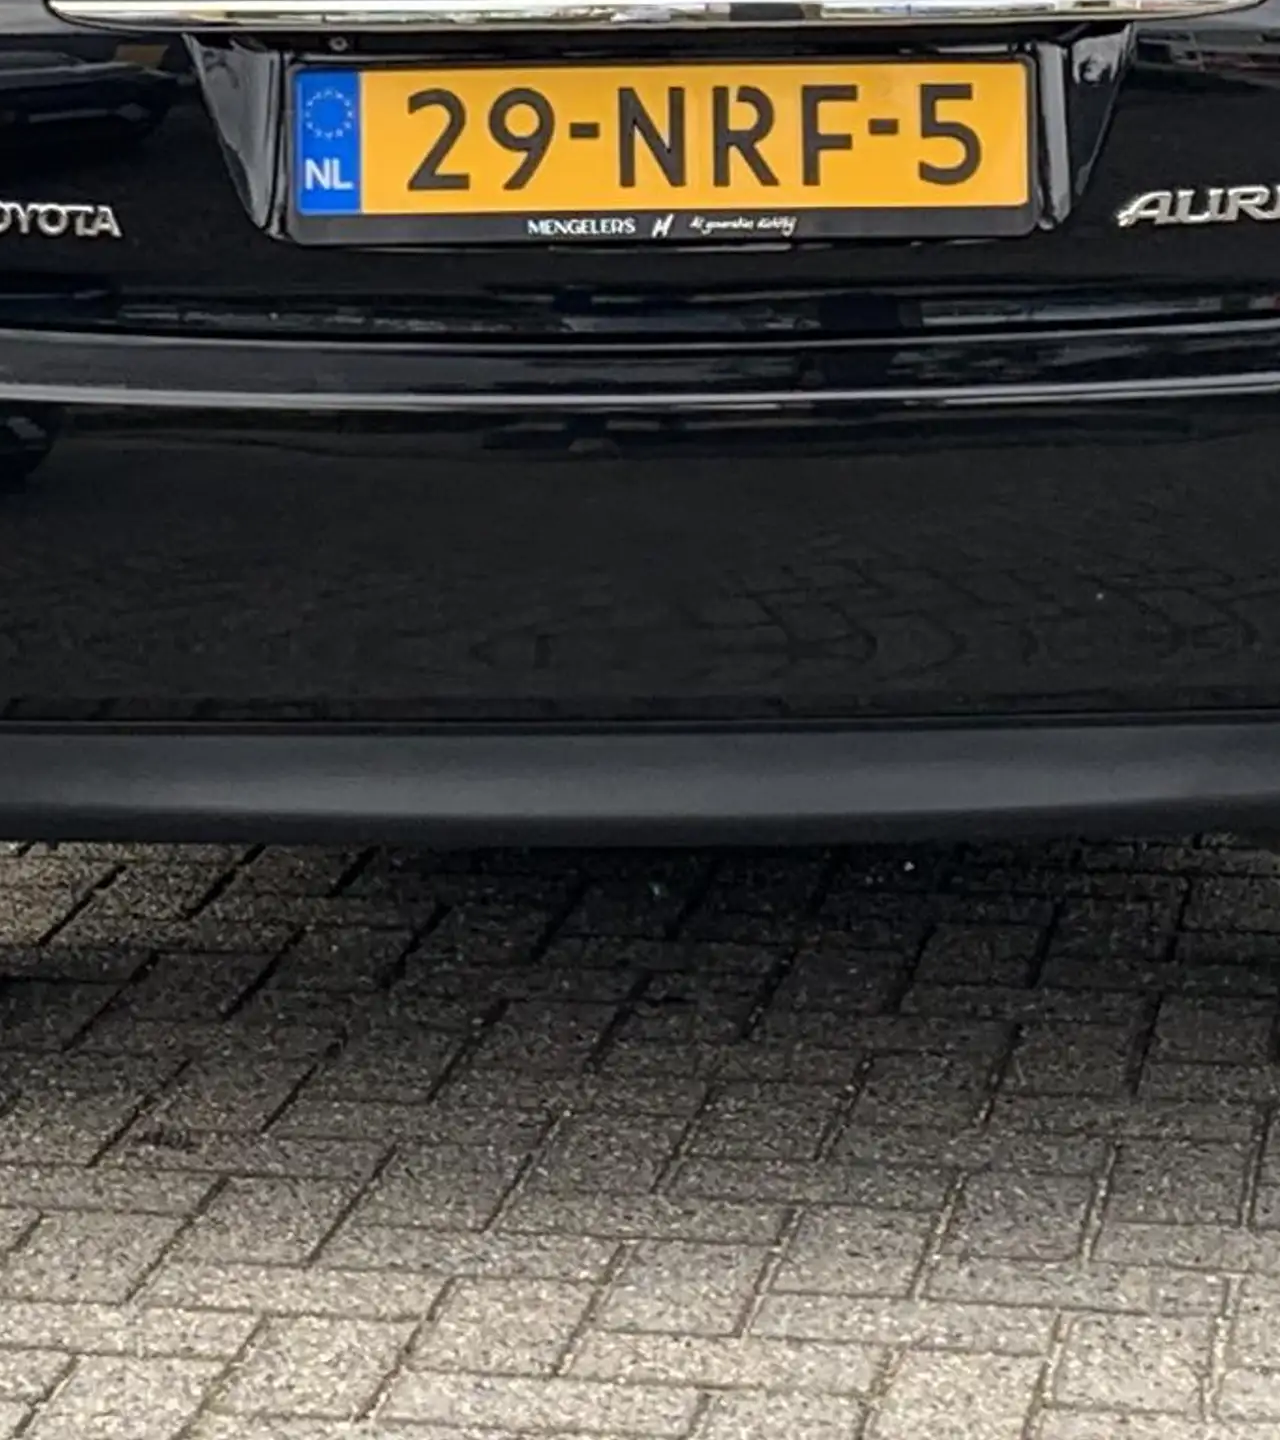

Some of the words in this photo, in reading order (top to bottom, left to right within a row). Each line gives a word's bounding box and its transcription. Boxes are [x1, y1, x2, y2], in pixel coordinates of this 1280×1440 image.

[405, 82, 982, 192] 29-NRF-5
[305, 159, 353, 191] NL
[527, 218, 636, 236] MENGELERS
